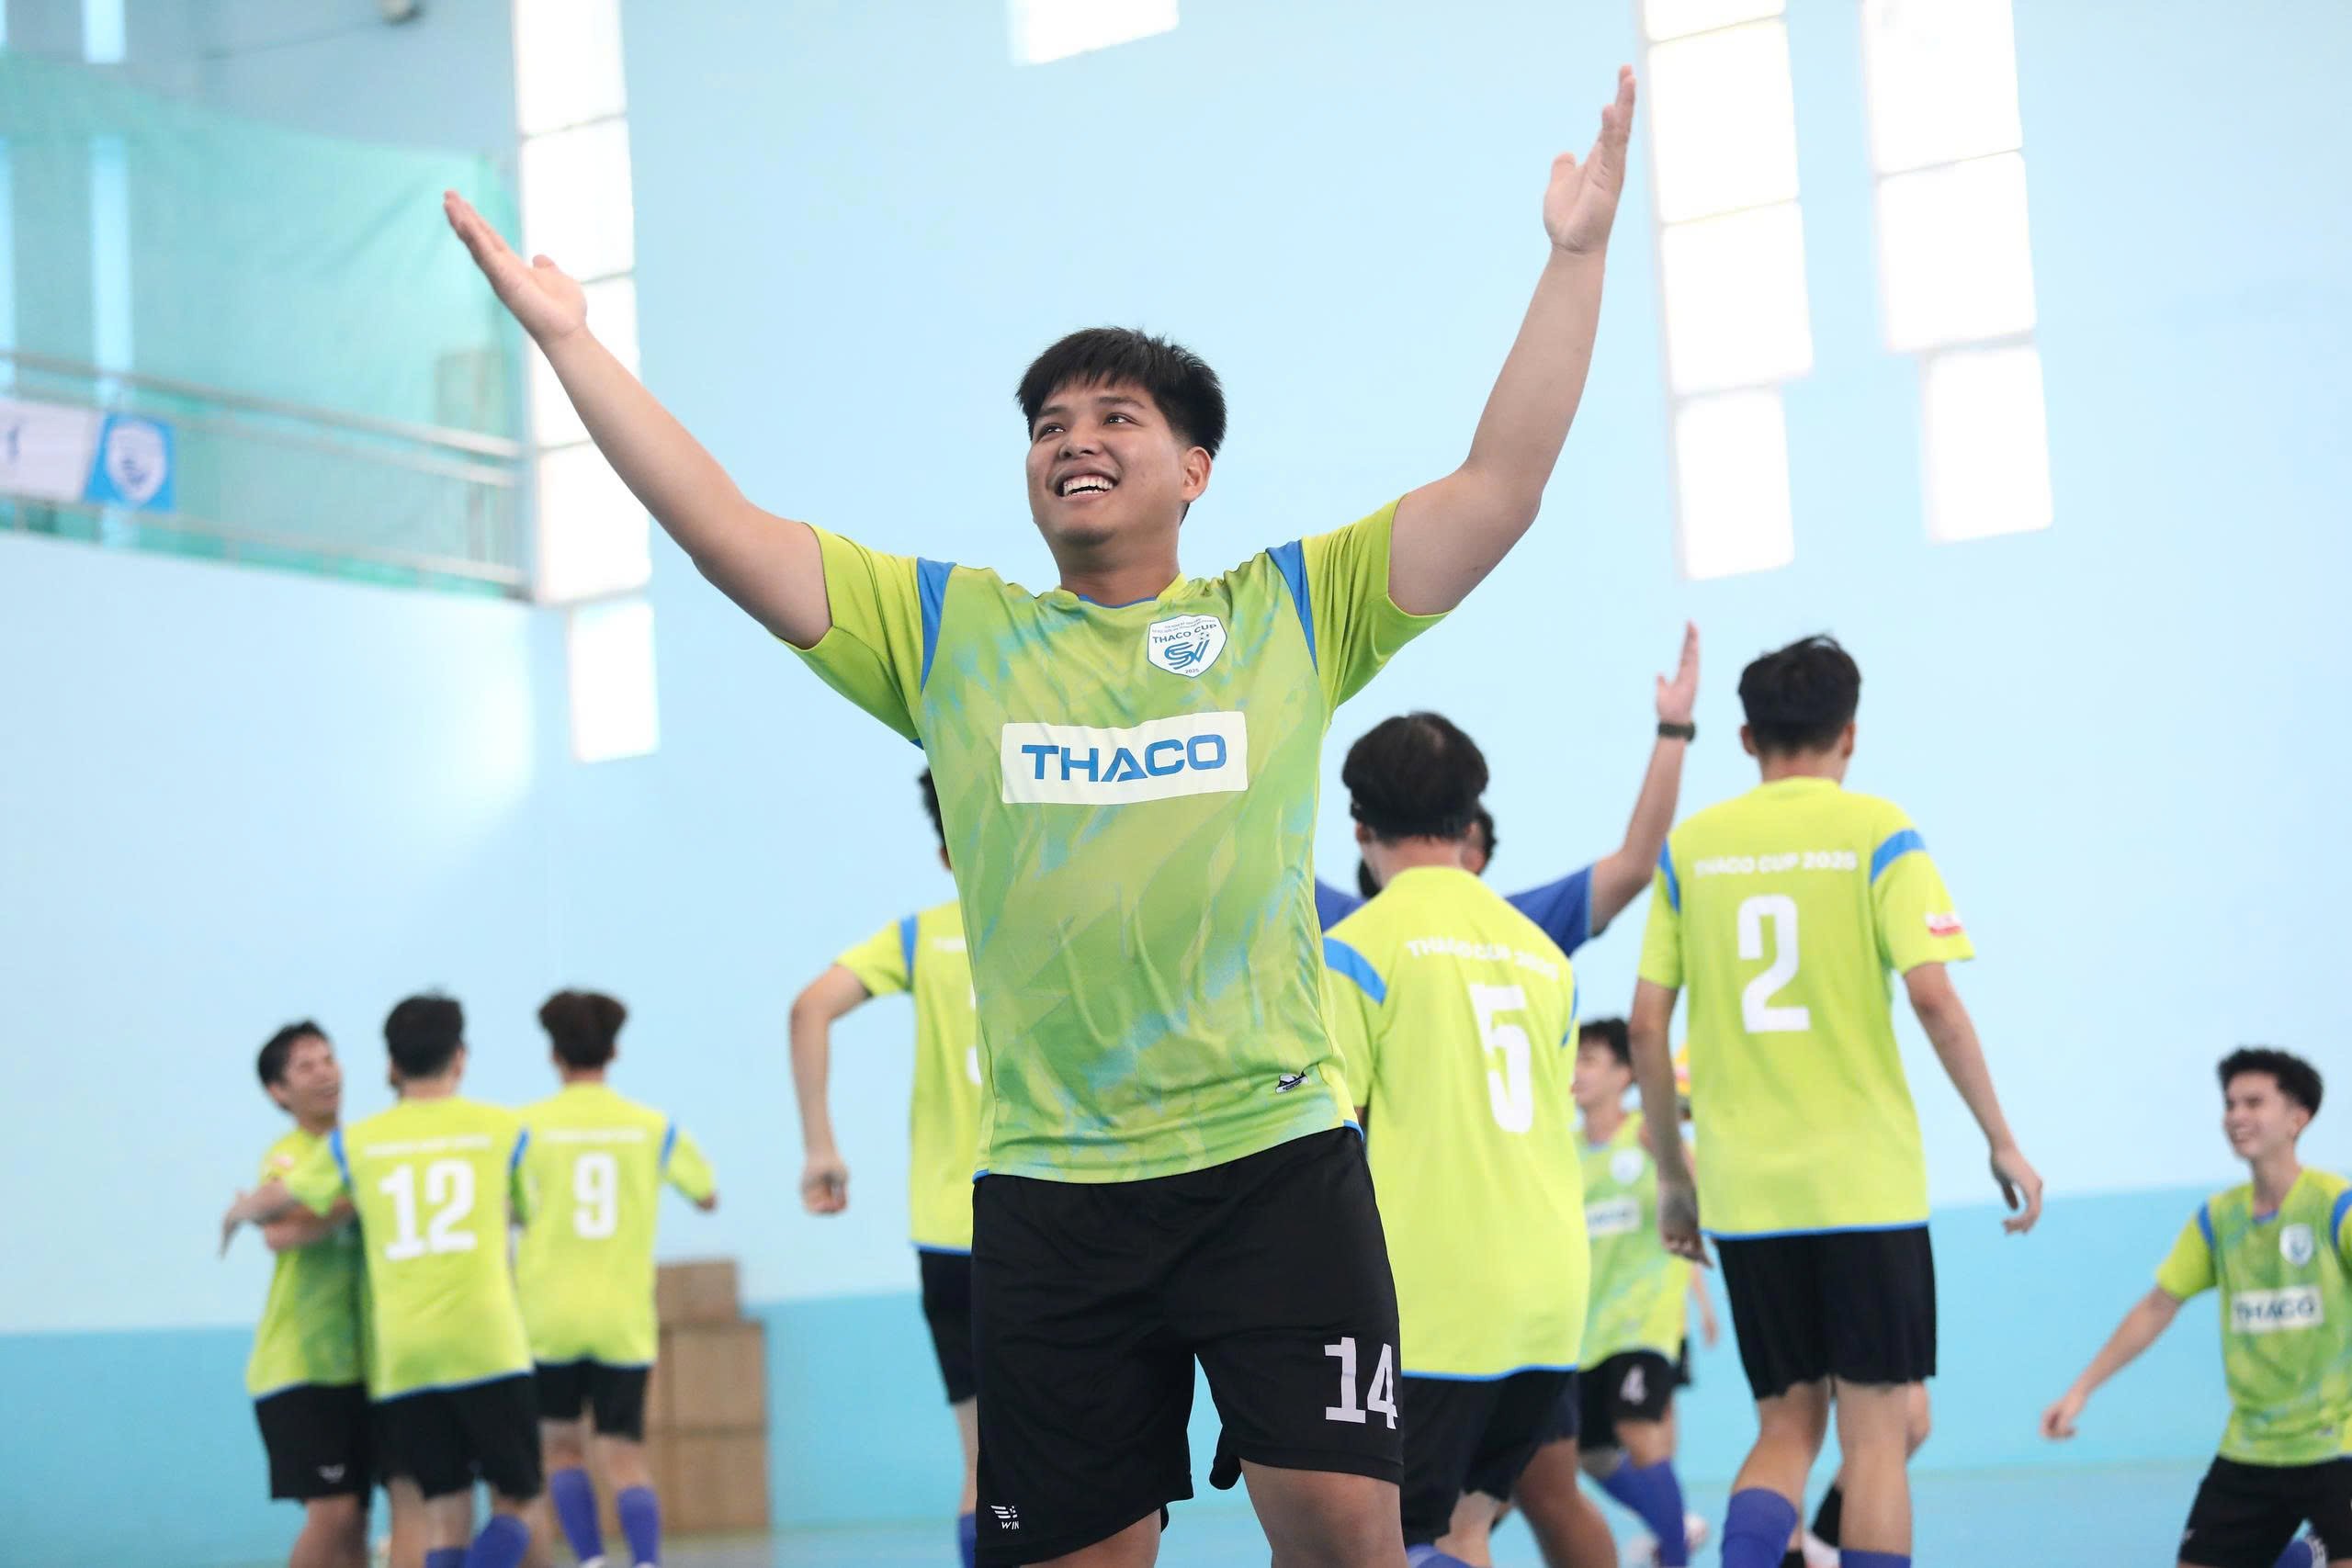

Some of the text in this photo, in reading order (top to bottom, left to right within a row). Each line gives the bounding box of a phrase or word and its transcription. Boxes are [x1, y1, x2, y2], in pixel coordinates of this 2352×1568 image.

[1152, 631, 1192, 644] THACO
[1194, 624, 1216, 634] CUP
[1022, 735, 1227, 782] THACO
[1758, 852, 1798, 874] CUP
[1738, 895, 1810, 1033] 2
[1469, 984, 1533, 1134] 5
[379, 1159, 477, 1259] 12
[573, 1153, 616, 1239] 9
[1324, 1337, 1398, 1430] 14
[1619, 1365, 1646, 1403] 4
[1001, 1521, 1020, 1529] WIN
